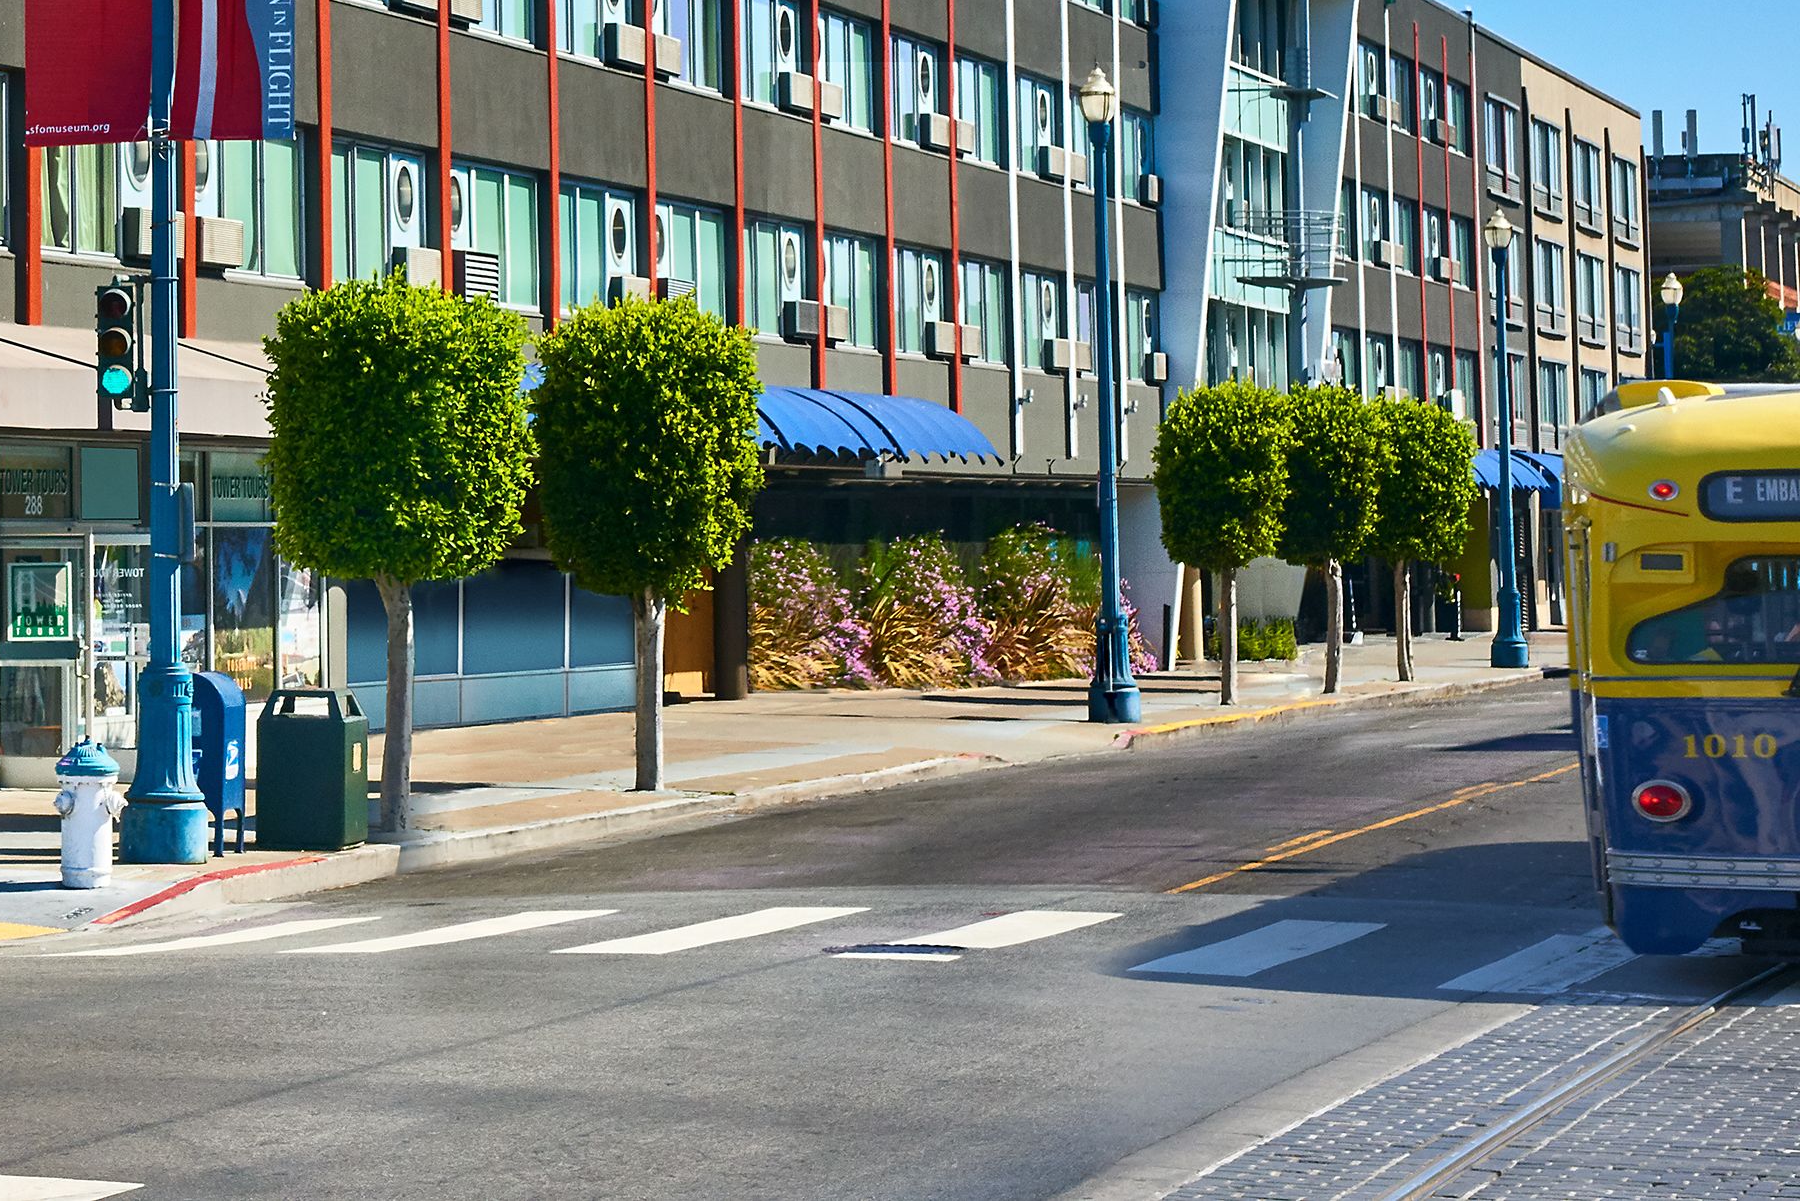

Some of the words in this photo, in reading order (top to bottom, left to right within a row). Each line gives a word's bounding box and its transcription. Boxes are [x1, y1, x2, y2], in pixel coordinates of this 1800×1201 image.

[273, 10, 287, 26] IN
[267, 31, 292, 130] FLIGHT
[29, 123, 110, 135] sfomuseum.org
[0, 469, 34, 494] TOWER
[36, 469, 68, 494] TOURS
[212, 477, 241, 498] TOWER
[242, 477, 269, 499] TOURS
[1725, 477, 1743, 504] E
[1756, 478, 1800, 502] EMBA
[25, 495, 43, 515] 288
[16, 615, 65, 627] TOWER
[16, 627, 65, 636] TOURS
[1683, 734, 1777, 758] 1010
